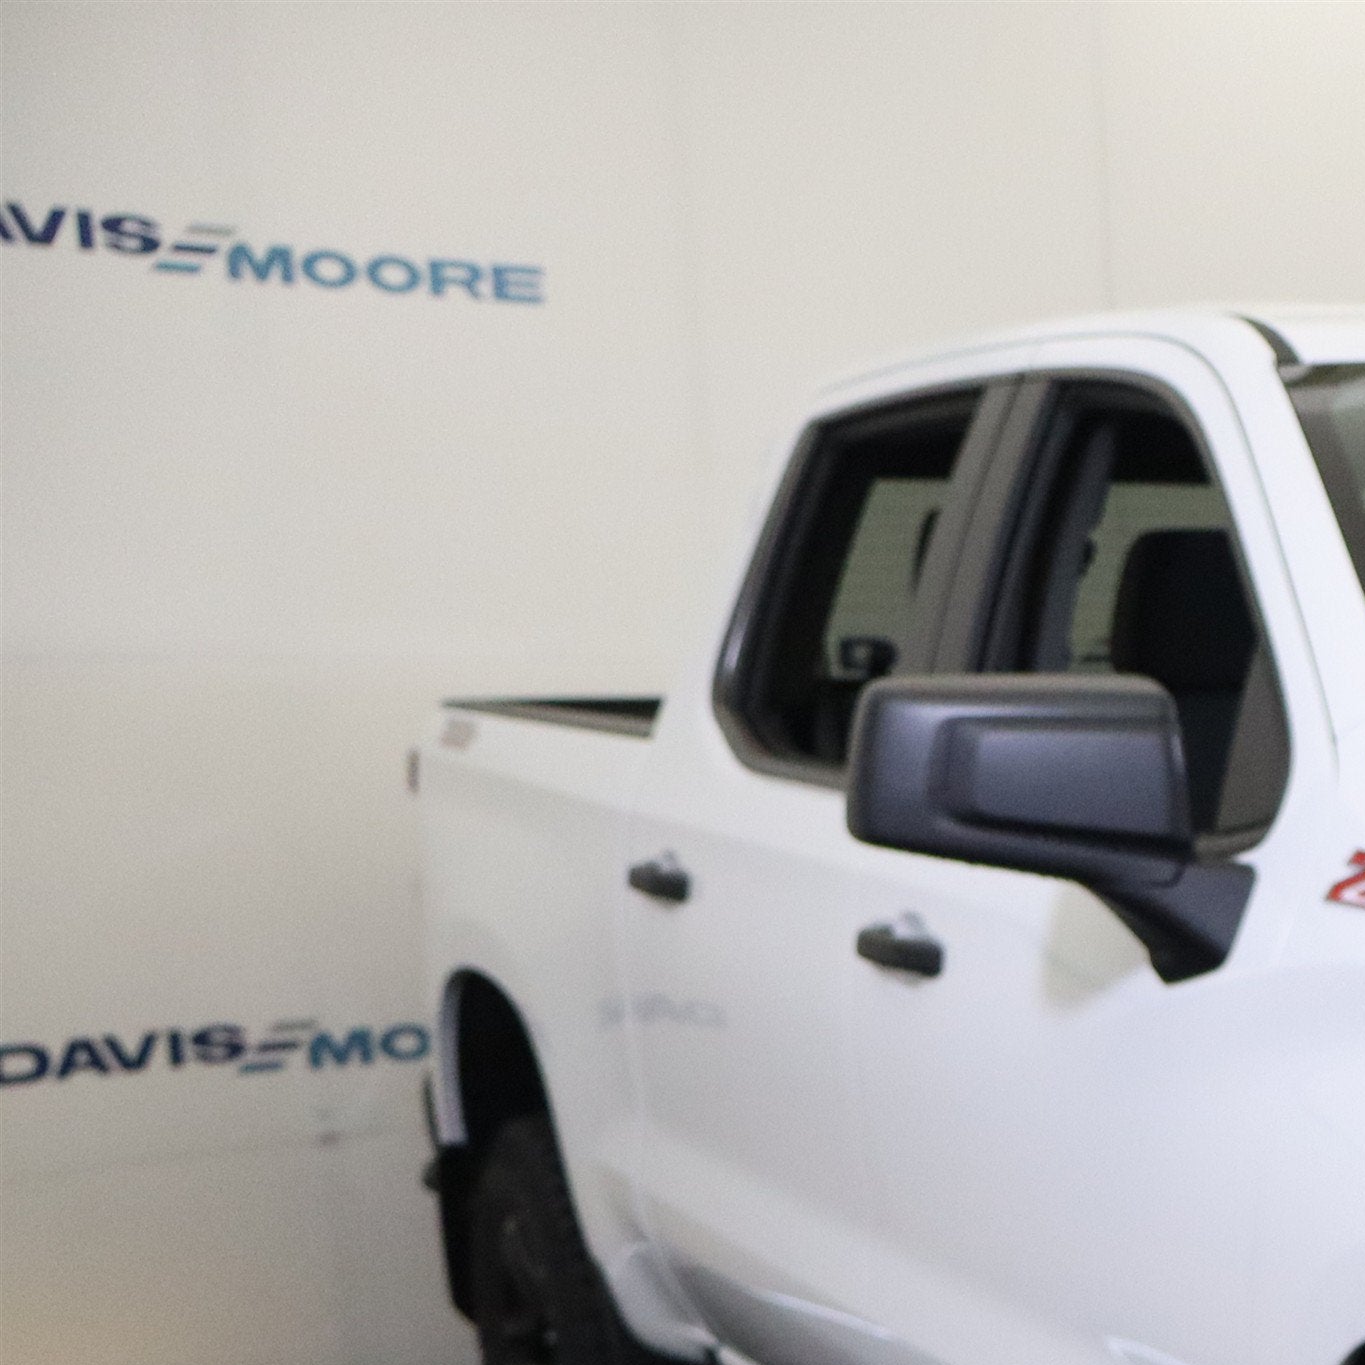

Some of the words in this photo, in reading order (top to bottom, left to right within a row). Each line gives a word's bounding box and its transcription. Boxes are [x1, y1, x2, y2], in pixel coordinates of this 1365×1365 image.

[0, 200, 163, 256] VIS
[226, 241, 547, 306] MOORE
[0, 1022, 247, 1087] DAVIS
